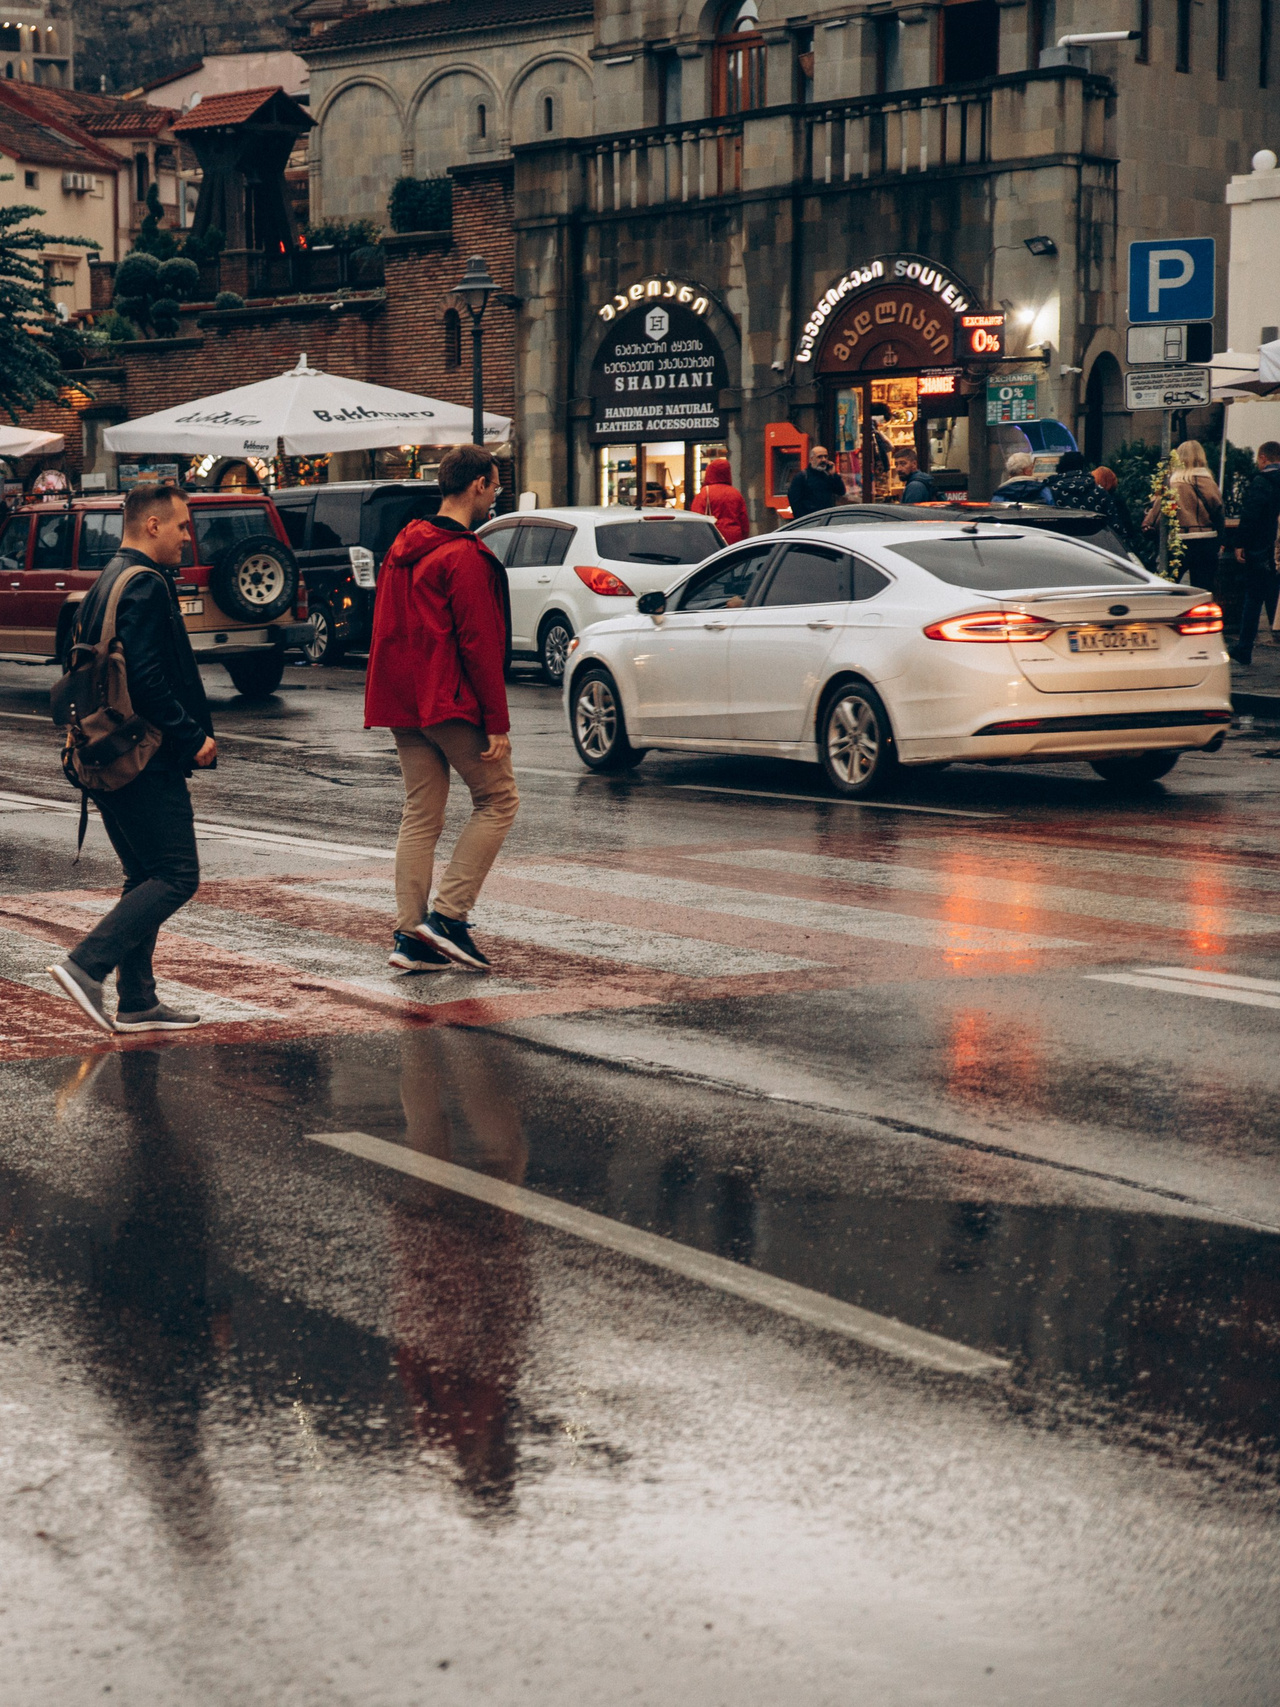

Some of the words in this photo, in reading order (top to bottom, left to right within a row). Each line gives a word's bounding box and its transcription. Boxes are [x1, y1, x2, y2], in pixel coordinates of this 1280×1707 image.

[894, 260, 969, 313] SOUVEN
[1147, 249, 1195, 313] P
[796, 260, 884, 362] სუვენირები
[962, 315, 1003, 327] EXCHANGE
[833, 301, 949, 361] მადლიანი
[971, 329, 1000, 353] 0%
[615, 372, 713, 392] SHADIANI
[989, 374, 1034, 383] EXCHANGE
[999, 387, 1024, 400] 0%
[313, 405, 435, 422] Bakhmaro
[605, 405, 663, 418] HANDMADE
[665, 403, 714, 416] NATURAL
[596, 420, 644, 433] LEATHER
[646, 417, 720, 431] ACCESSORIES
